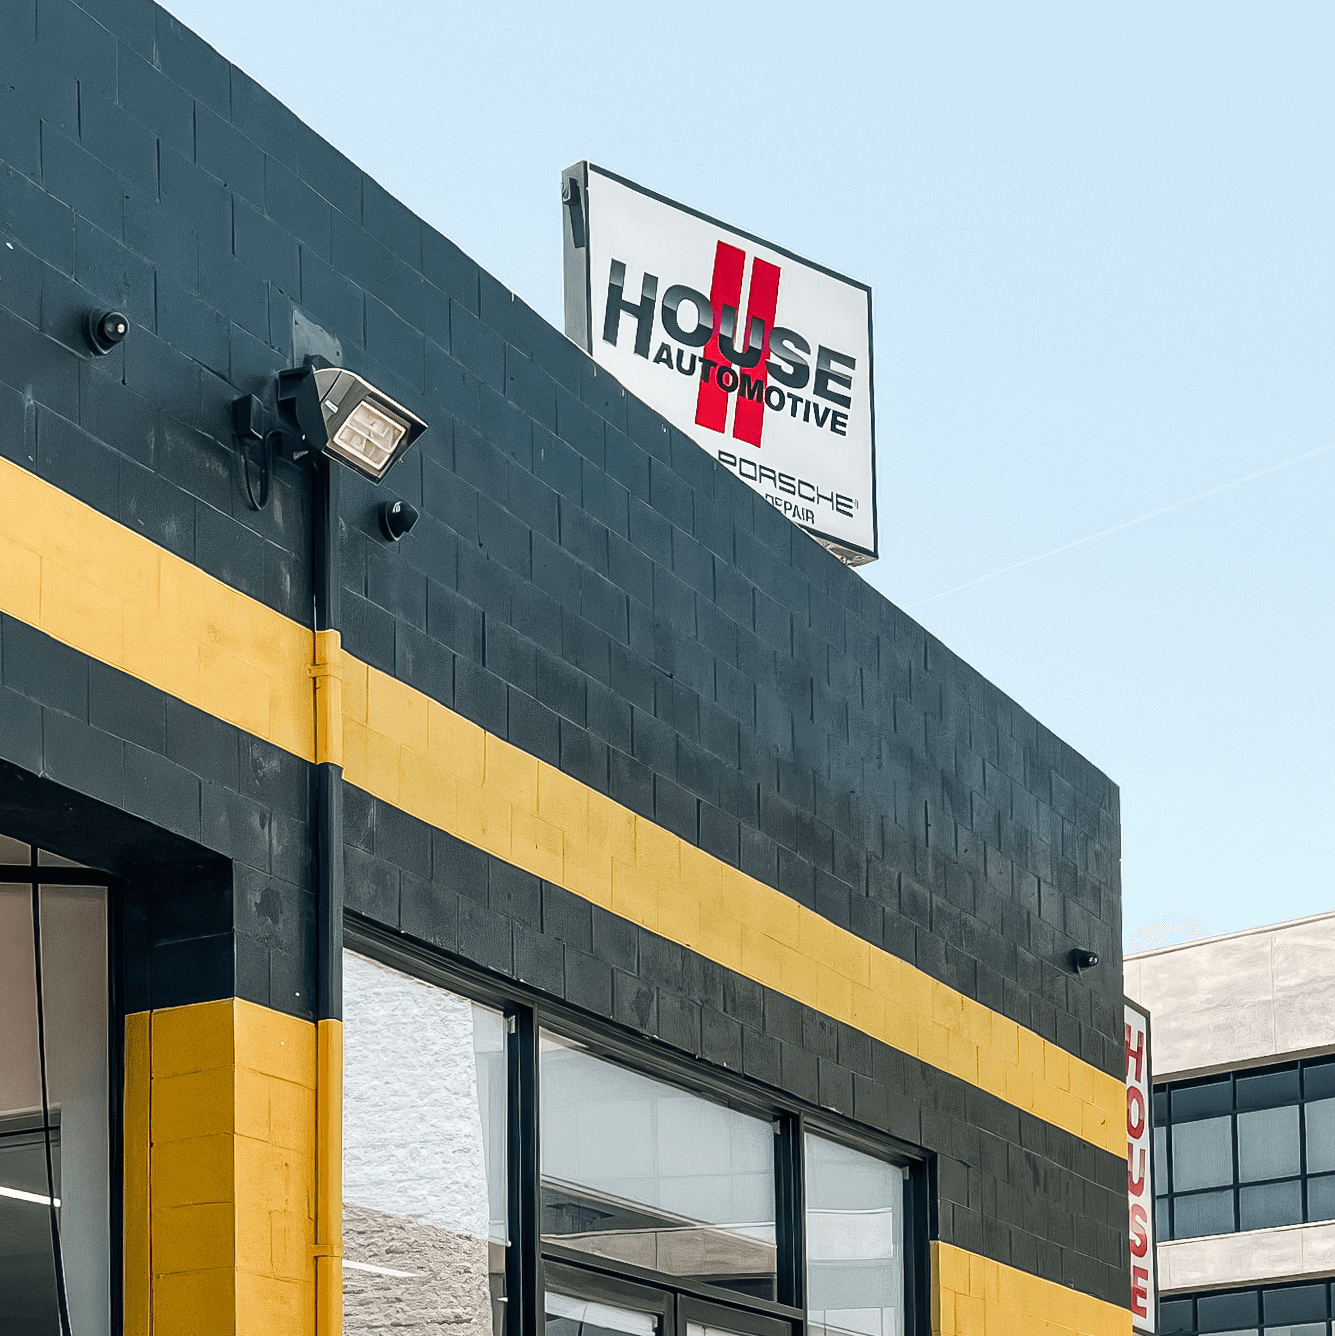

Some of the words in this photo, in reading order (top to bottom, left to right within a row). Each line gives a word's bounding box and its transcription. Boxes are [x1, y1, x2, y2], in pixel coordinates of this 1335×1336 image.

[602, 258, 857, 410] HOUSE
[652, 341, 849, 436] AUTOMOTIVE
[718, 450, 855, 519] PORSCHE
[1124, 1022, 1149, 1320] HOUSE
